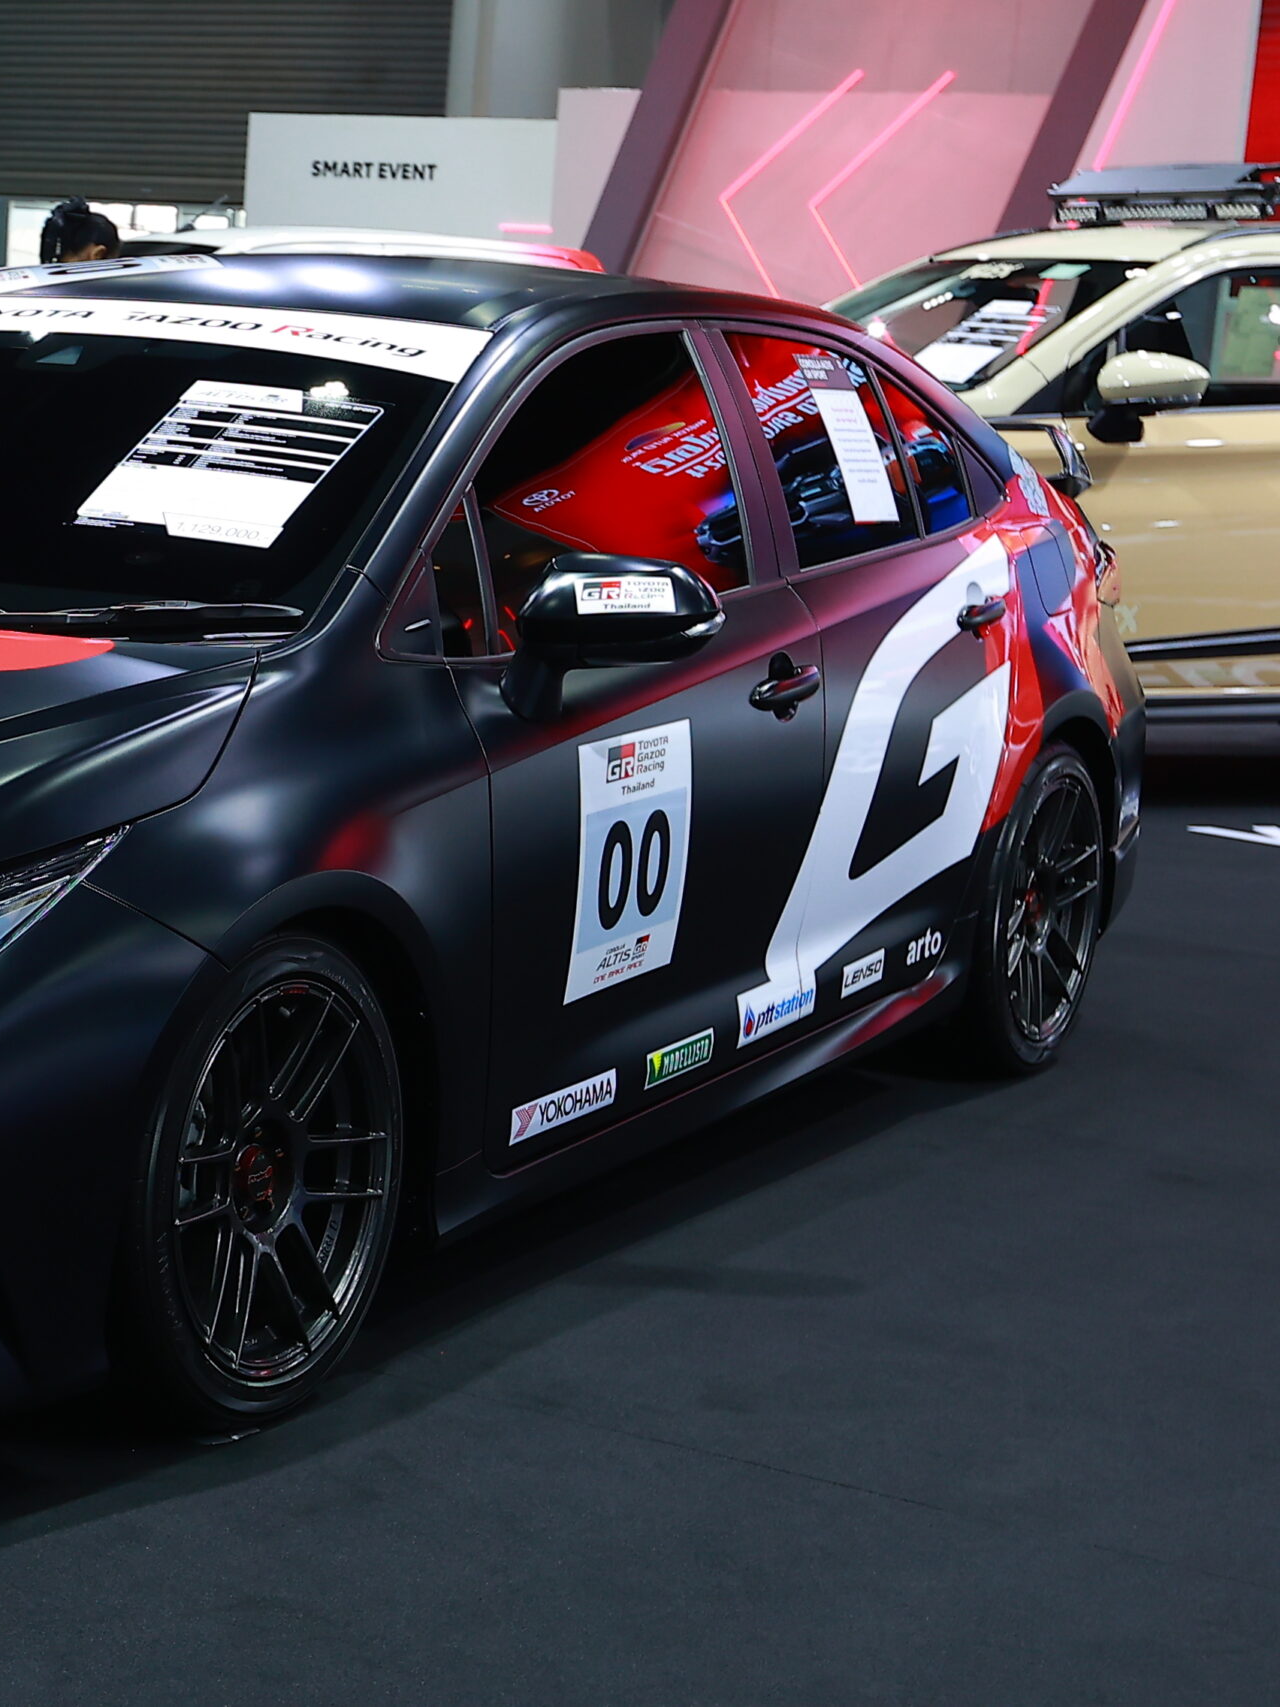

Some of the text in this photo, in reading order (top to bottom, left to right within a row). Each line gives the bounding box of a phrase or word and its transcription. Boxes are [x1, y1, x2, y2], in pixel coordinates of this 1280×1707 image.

[312, 160, 437, 180] SMART EVENT
[271, 325, 427, 358] Racing
[582, 587, 620, 601] GR
[603, 602, 651, 610] Thailand
[638, 735, 669, 750] TOYOTA
[636, 748, 666, 763] GAZOO
[607, 756, 635, 782] GR
[636, 760, 665, 775] Racing
[621, 778, 656, 796] Thailand
[597, 809, 671, 930] 00
[906, 927, 942, 967] arto
[596, 948, 631, 972] ALTIS
[843, 959, 883, 988] LENSO
[539, 1077, 613, 1126] YOKOHAMA
